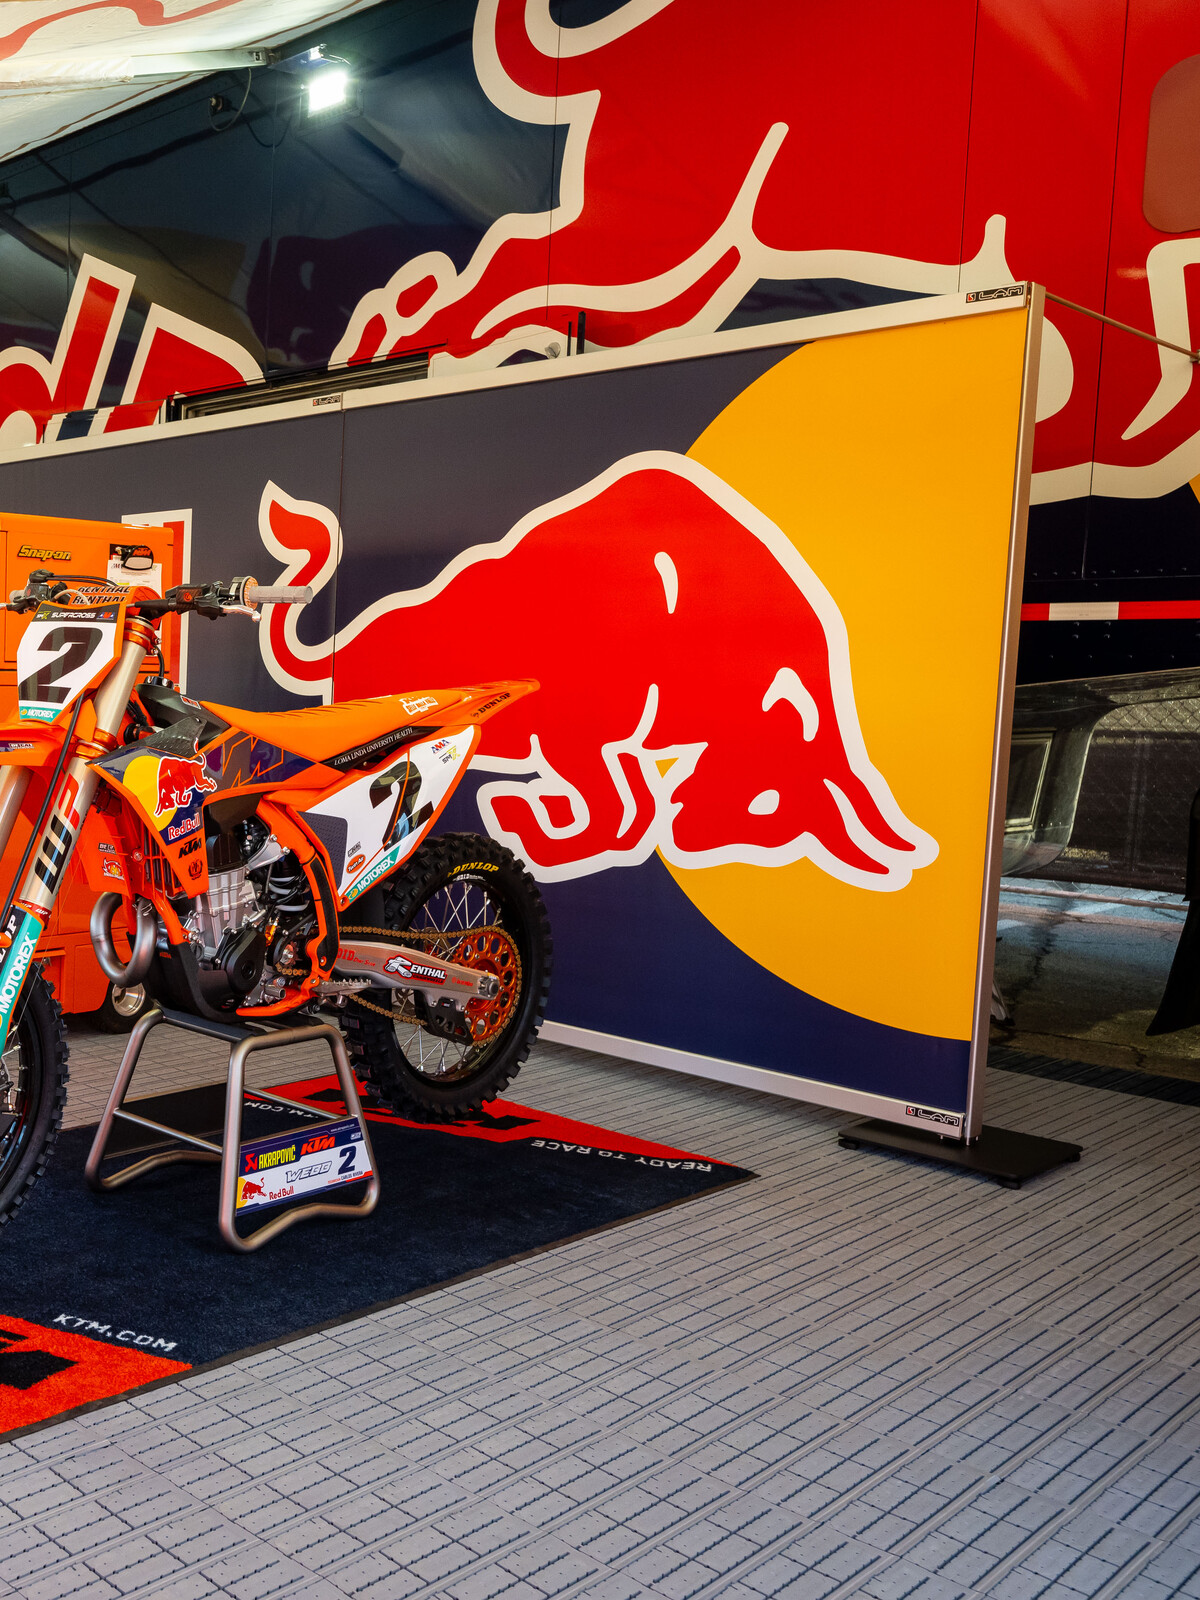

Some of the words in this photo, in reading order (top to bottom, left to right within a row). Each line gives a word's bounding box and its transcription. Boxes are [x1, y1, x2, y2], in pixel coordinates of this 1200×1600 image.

[979, 286, 1022, 300] LAM
[18, 545, 72, 561] Snap-on
[17, 626, 104, 704] 2
[27, 709, 55, 718] MOTOREX
[477, 692, 512, 714] DUNLOP
[334, 754, 351, 766] LOMA
[351, 748, 367, 760] LINDA
[366, 735, 395, 753] UNIVERSITY
[394, 727, 414, 741] HEALTH
[430, 739, 451, 754] AMA
[368, 760, 435, 853] 2
[35, 773, 80, 894] WP
[168, 823, 186, 840] Red
[185, 812, 200, 833] Bull
[178, 837, 201, 859] KTM
[357, 856, 396, 892] MOTOREX
[450, 861, 500, 875] DUNLOP
[384, 956, 447, 979] RENTHAL
[244, 1101, 319, 1119] TM.COM
[918, 1110, 958, 1126] LAM
[300, 1135, 335, 1156] KTM
[530, 1139, 597, 1155] RACE
[598, 1149, 634, 1161] TO
[338, 1145, 357, 1175] 2
[636, 1156, 712, 1173] READY
[285, 1161, 332, 1184] WEBB
[269, 1189, 282, 1200] Red
[282, 1186, 294, 1197] Bull
[52, 1314, 178, 1353] KTM.COM
